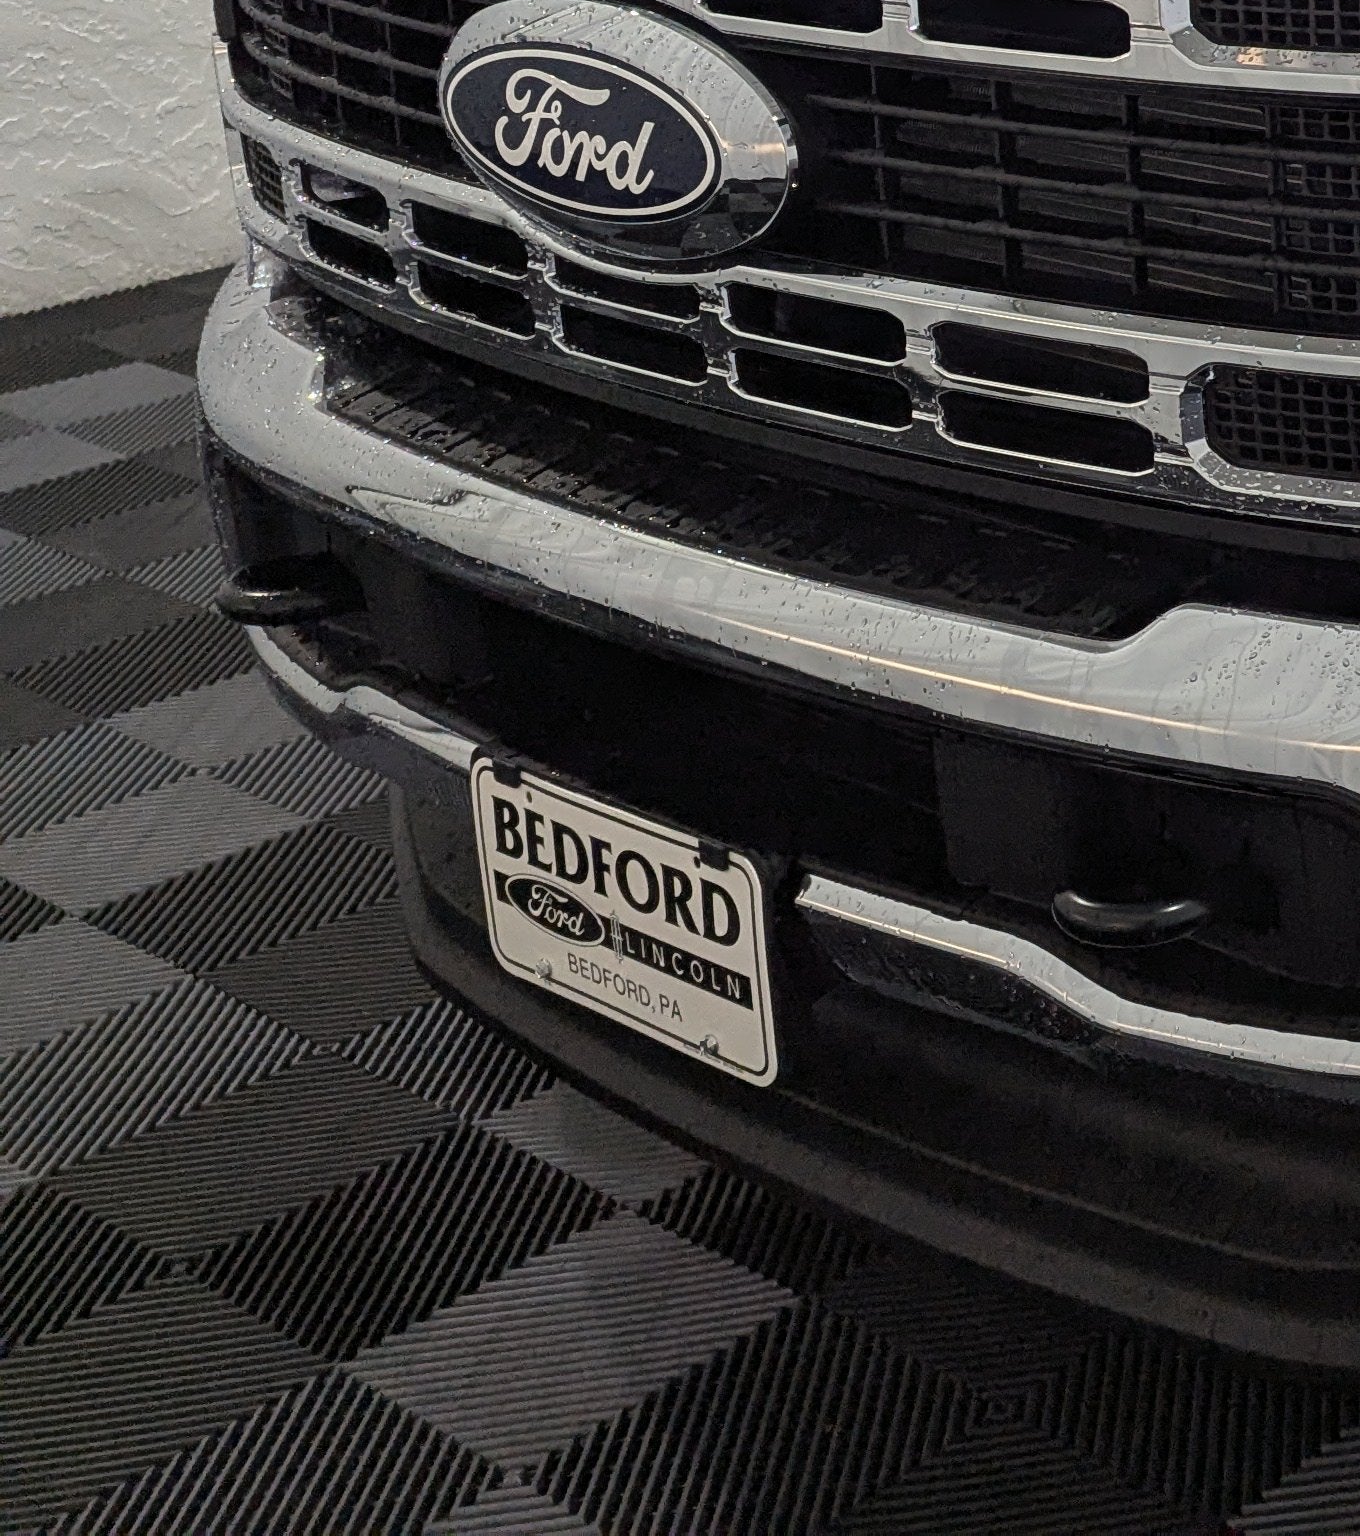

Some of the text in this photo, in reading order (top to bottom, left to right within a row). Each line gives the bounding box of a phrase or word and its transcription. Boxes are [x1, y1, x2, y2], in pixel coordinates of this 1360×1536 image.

[494, 68, 655, 196] Ford
[490, 795, 741, 947] BEDFORD
[527, 883, 585, 938] Ford
[567, 952, 683, 1023] BEDFORD, PA
[626, 936, 743, 1001] LINCOLN
